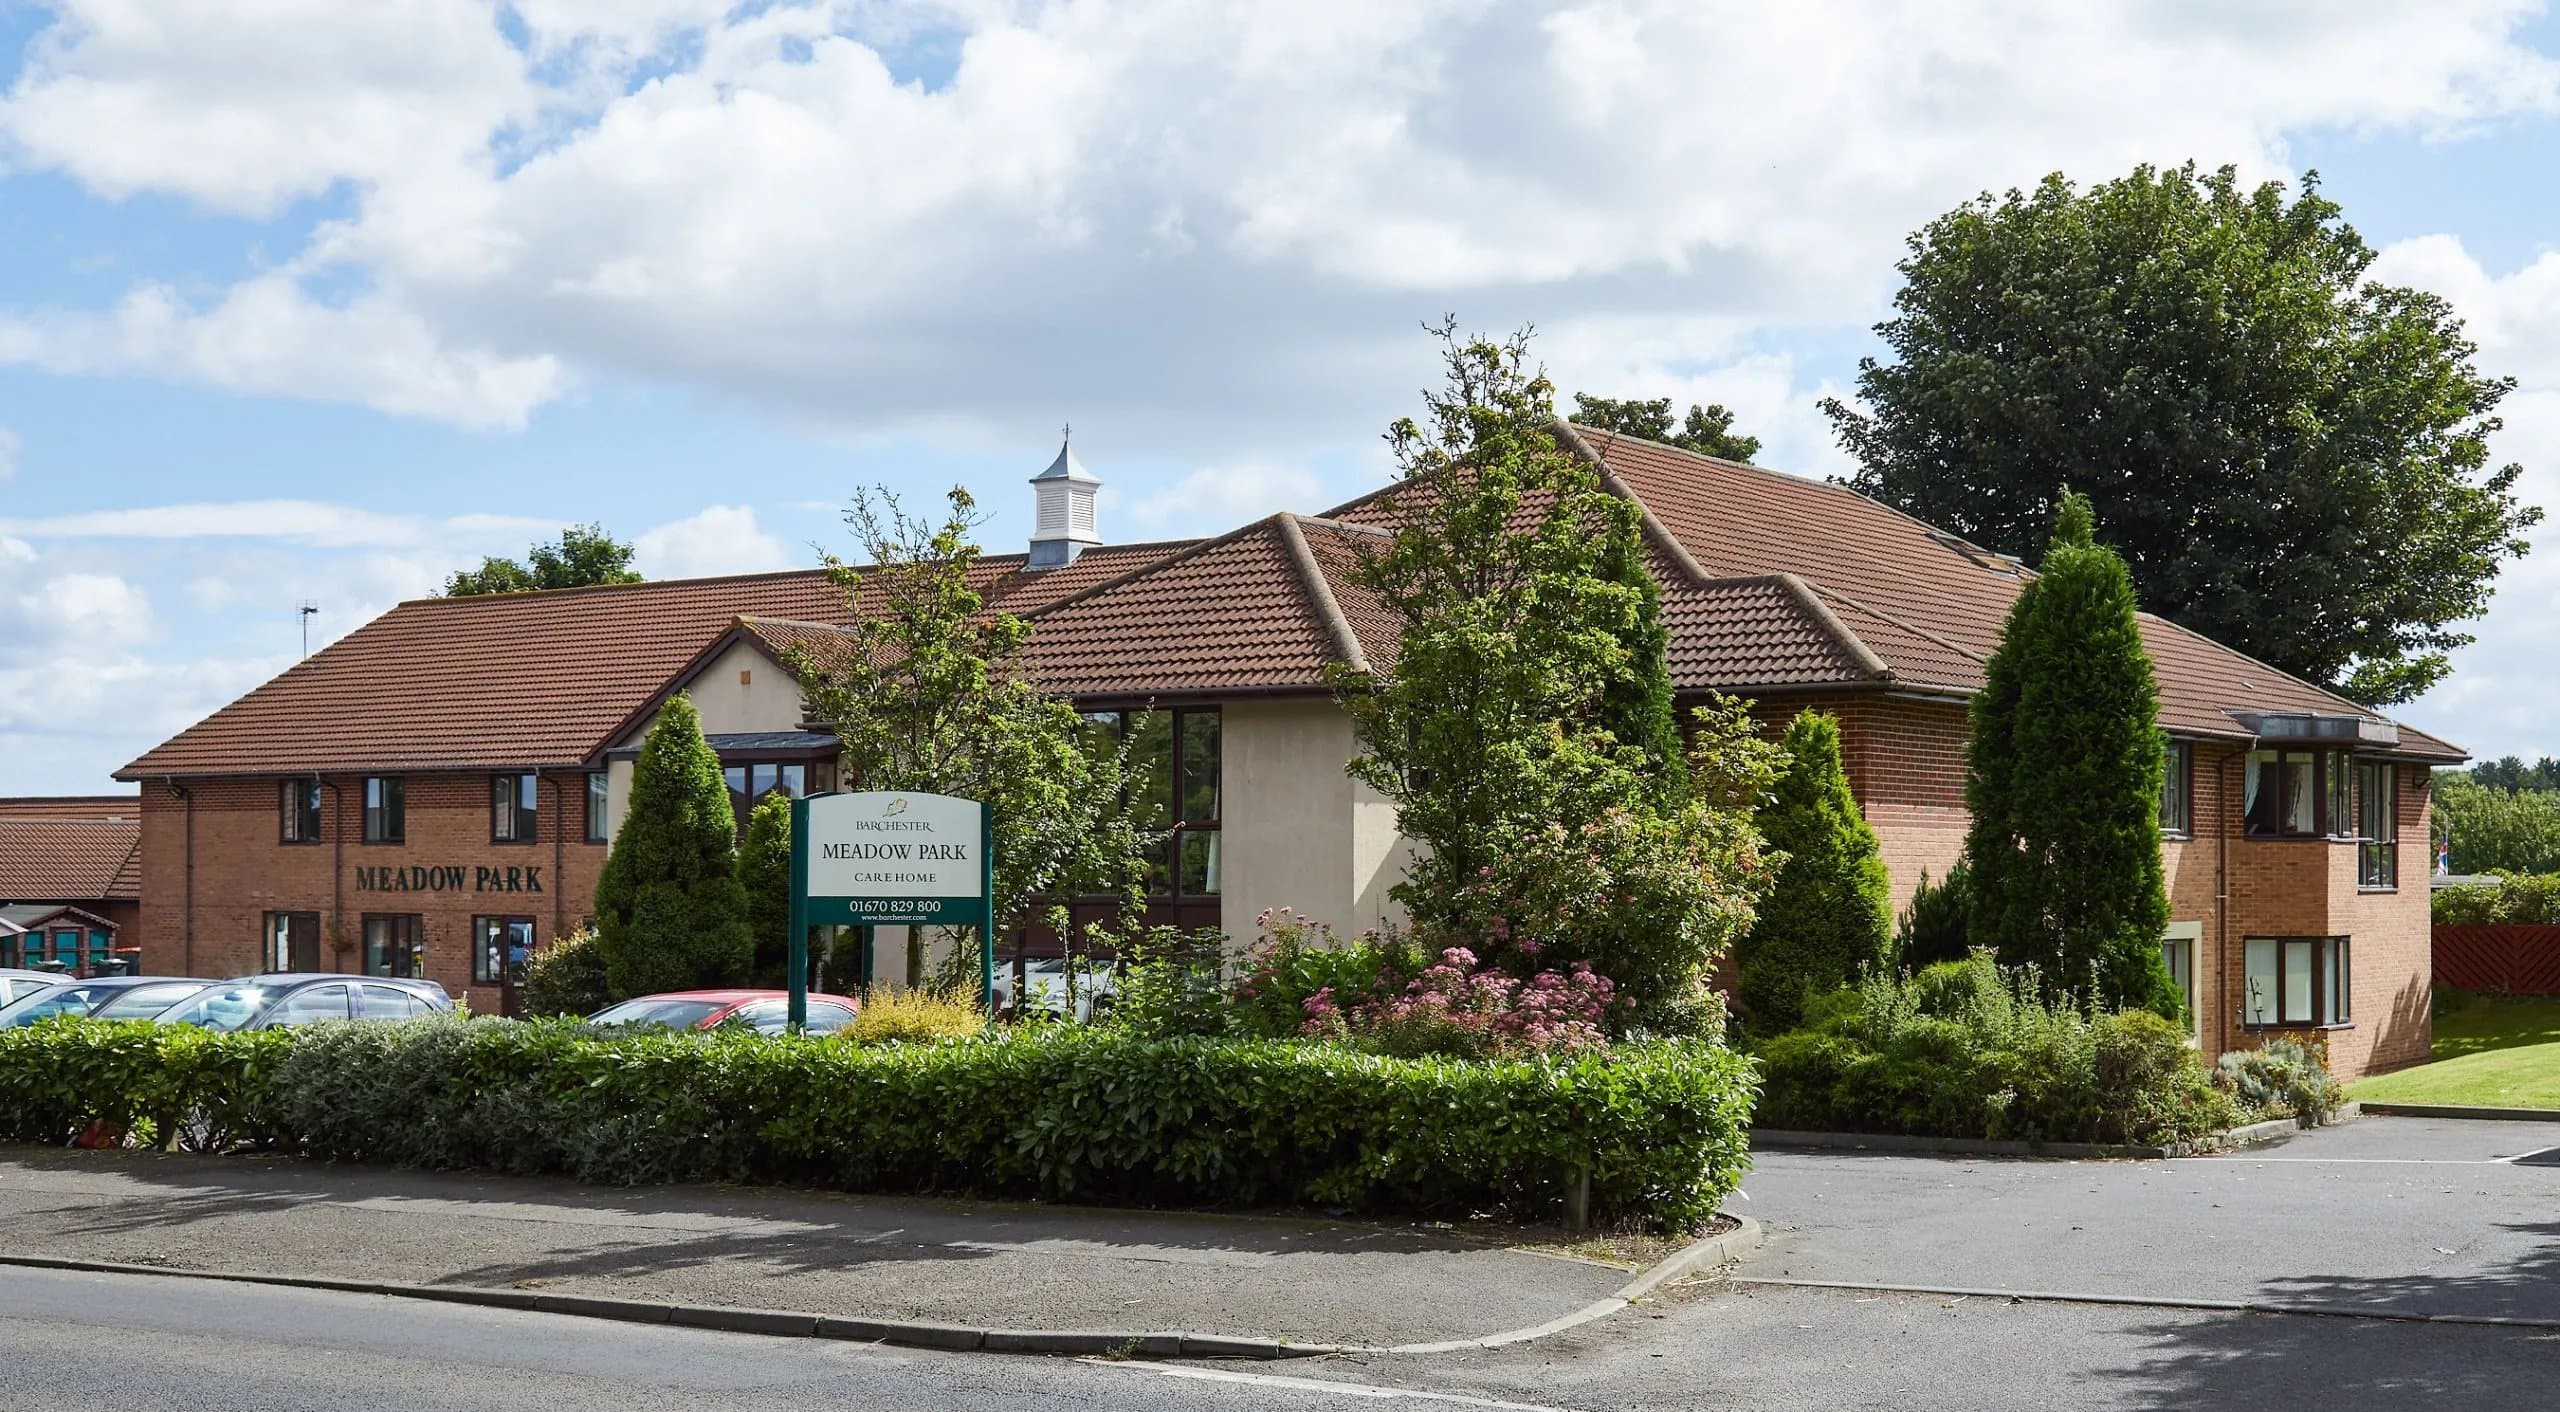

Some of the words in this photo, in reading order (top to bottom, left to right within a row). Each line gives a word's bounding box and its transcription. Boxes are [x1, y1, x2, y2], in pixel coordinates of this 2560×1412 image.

[856, 821, 936, 832] BARCHESTER
[823, 843, 912, 859] MEADOW
[919, 844, 967, 860] PARK
[356, 866, 466, 892] MEADOW
[475, 866, 543, 892] PARK
[849, 901, 888, 912] 01670
[890, 901, 914, 912] 829
[917, 901, 941, 912] 800
